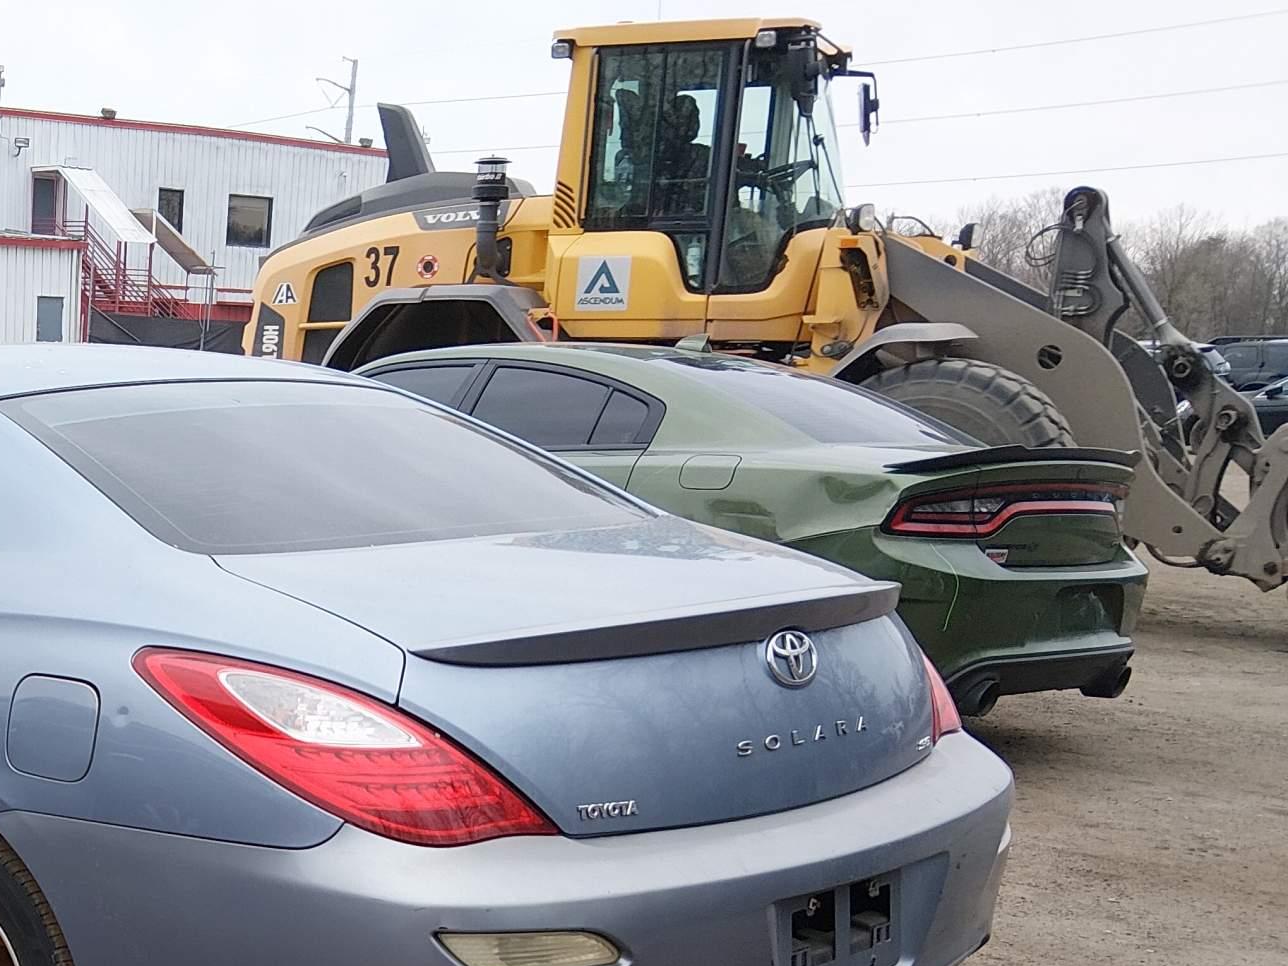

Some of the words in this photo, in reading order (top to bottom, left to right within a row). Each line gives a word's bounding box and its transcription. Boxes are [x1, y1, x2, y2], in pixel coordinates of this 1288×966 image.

[424, 208, 501, 224] VOLV
[364, 246, 400, 288] 37
[577, 296, 625, 305] ASCENDUM
[737, 716, 868, 757] SOLARA
[576, 800, 639, 820] TOYOTA
